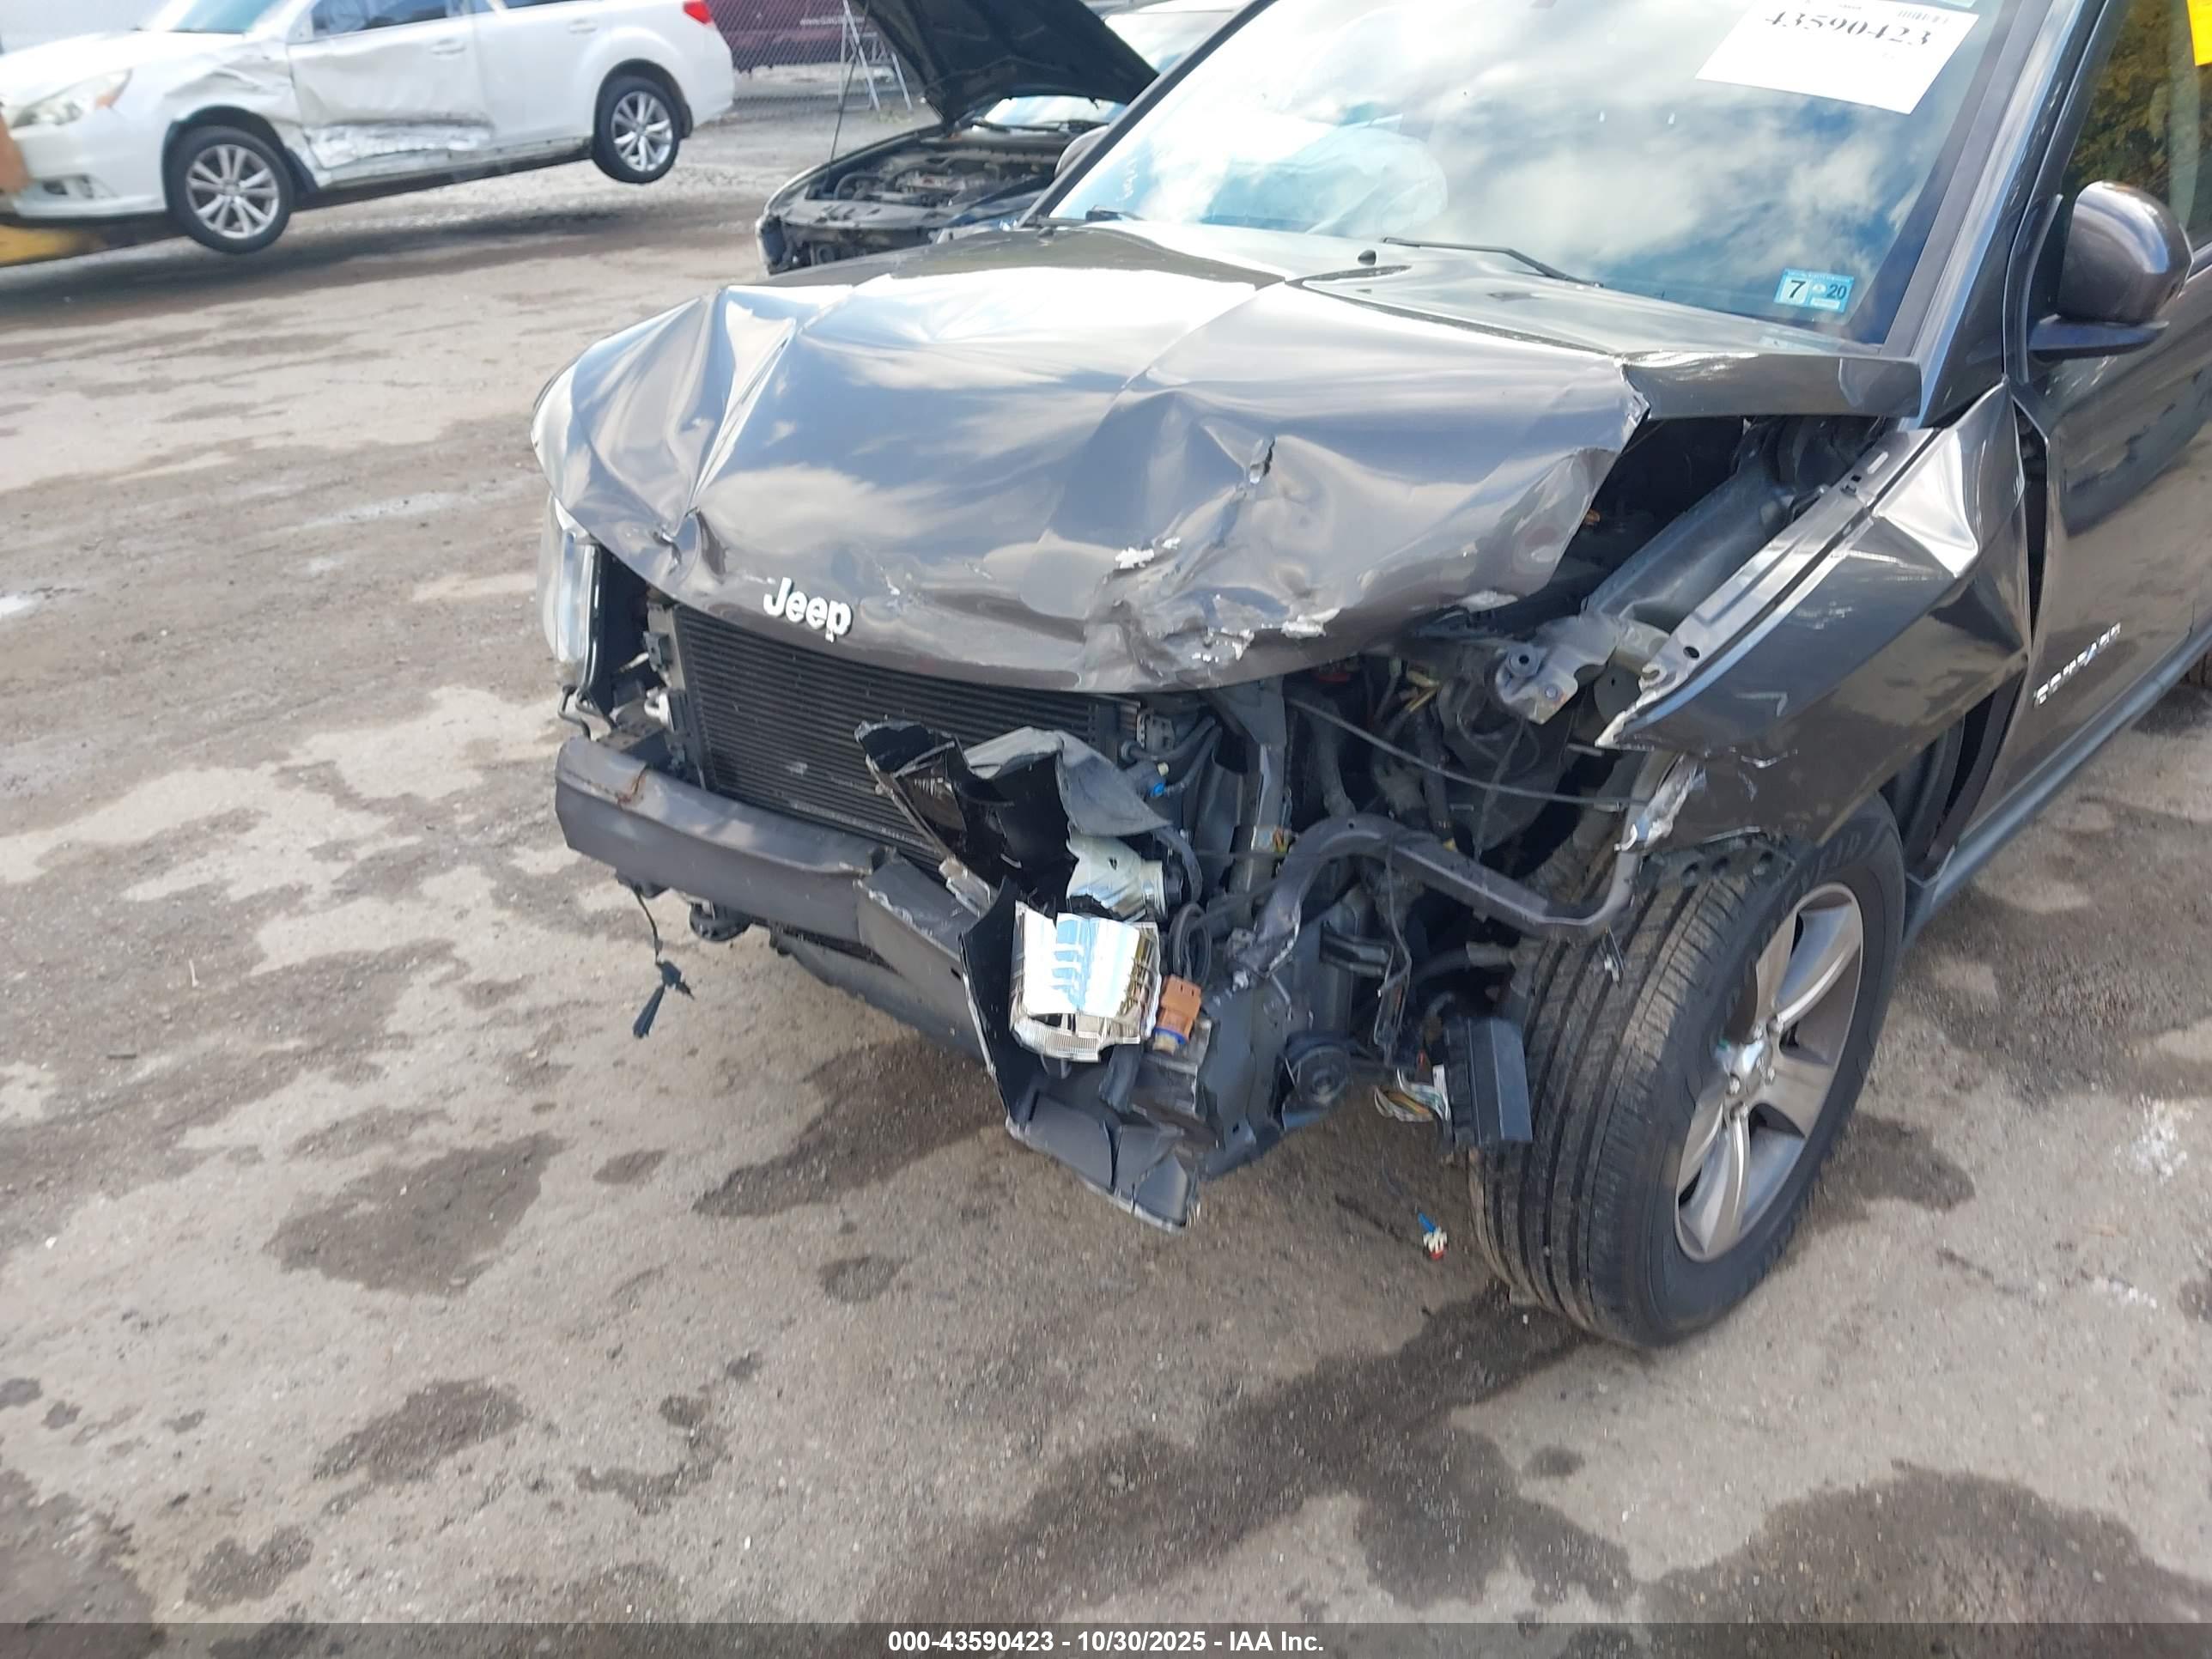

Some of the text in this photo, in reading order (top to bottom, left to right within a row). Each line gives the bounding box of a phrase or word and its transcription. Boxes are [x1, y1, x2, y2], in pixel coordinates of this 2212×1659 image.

[1765, 10, 1931, 46] 43590423
[1789, 279, 1848, 301] 7 20
[763, 576, 852, 644] Jeep
